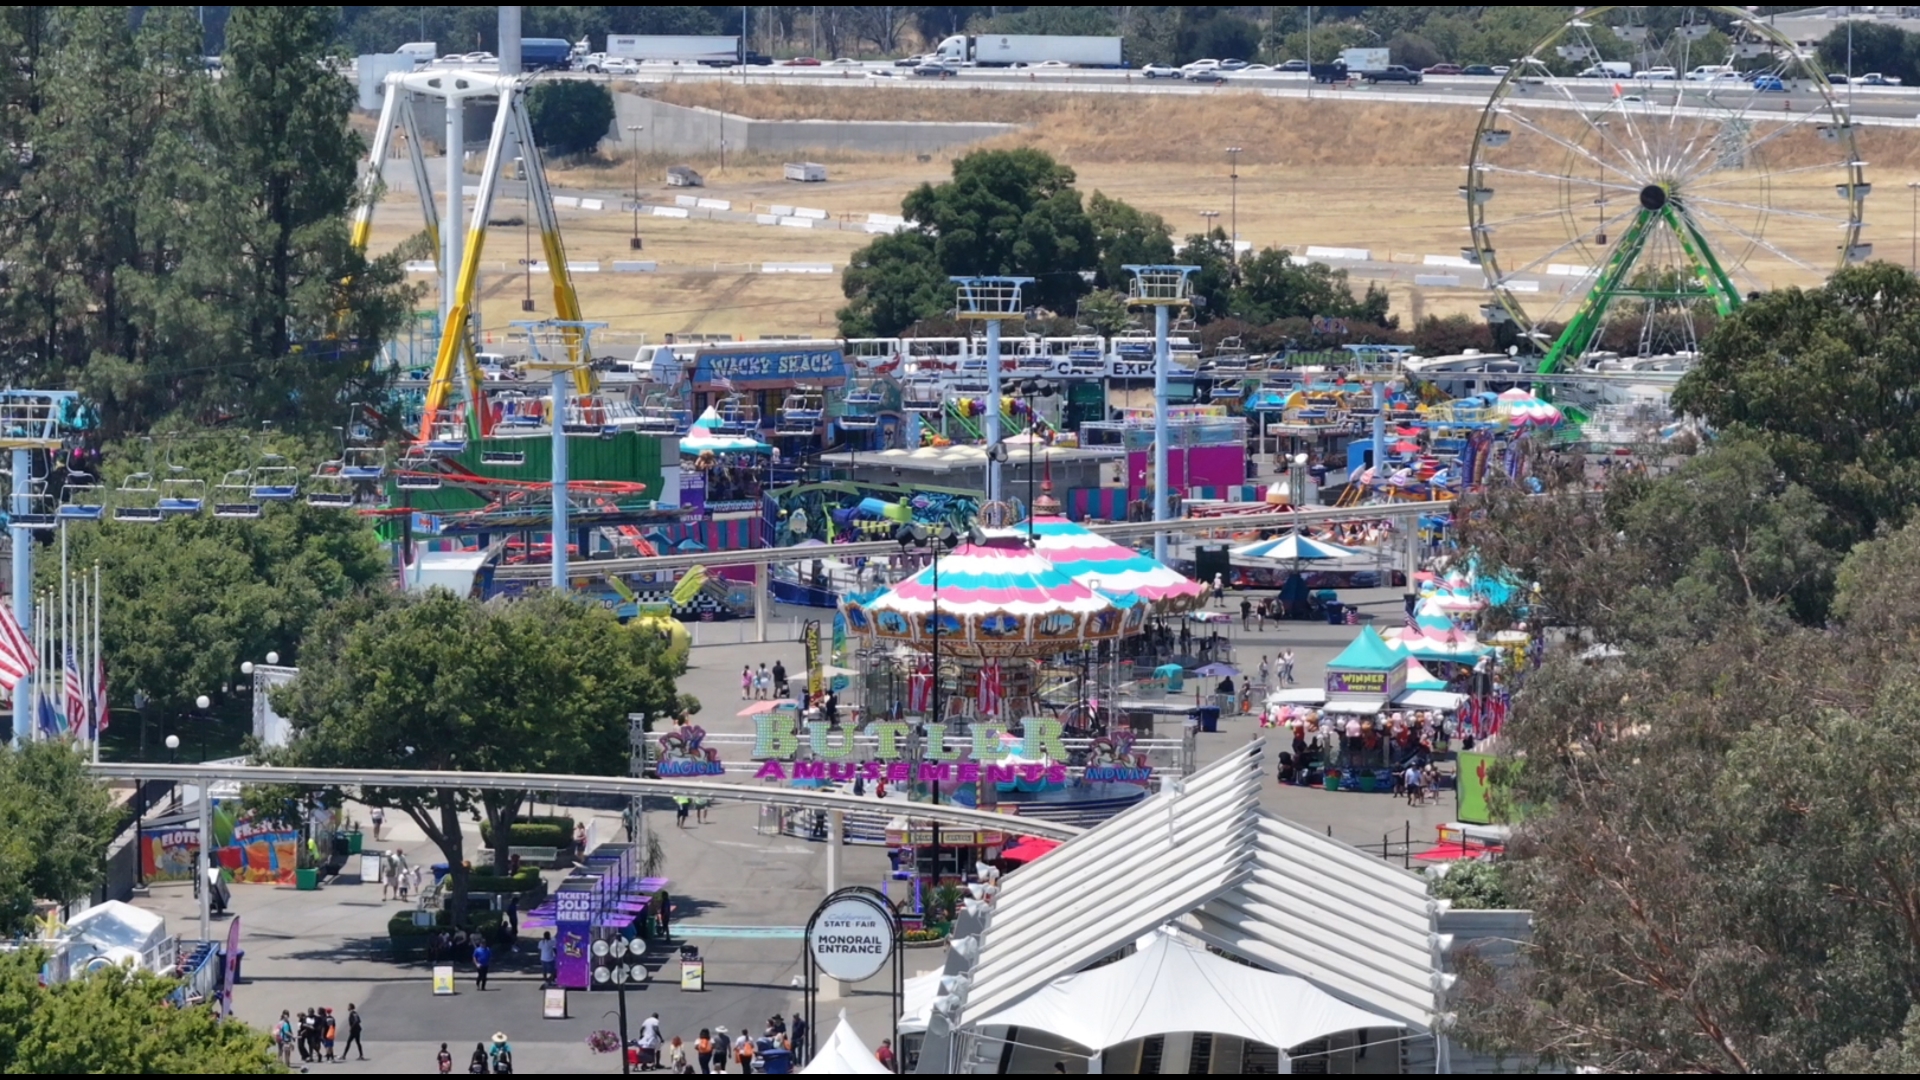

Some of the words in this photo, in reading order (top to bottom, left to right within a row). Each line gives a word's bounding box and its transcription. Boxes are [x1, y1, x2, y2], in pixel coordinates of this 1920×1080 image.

[710, 356, 771, 375] WACKY
[778, 353, 833, 373] SHACK
[1342, 674, 1384, 683] WINNER
[752, 713, 1070, 760] BUTLER
[656, 760, 724, 775] MAGICAL
[752, 760, 1068, 783] AMUSEMENTS
[1084, 767, 1151, 780] MIDWAY
[557, 901, 589, 910] SOLD
[557, 911, 590, 920] HERE!
[818, 935, 882, 944] MONORAIL
[818, 944, 882, 954] ENTRANCE
